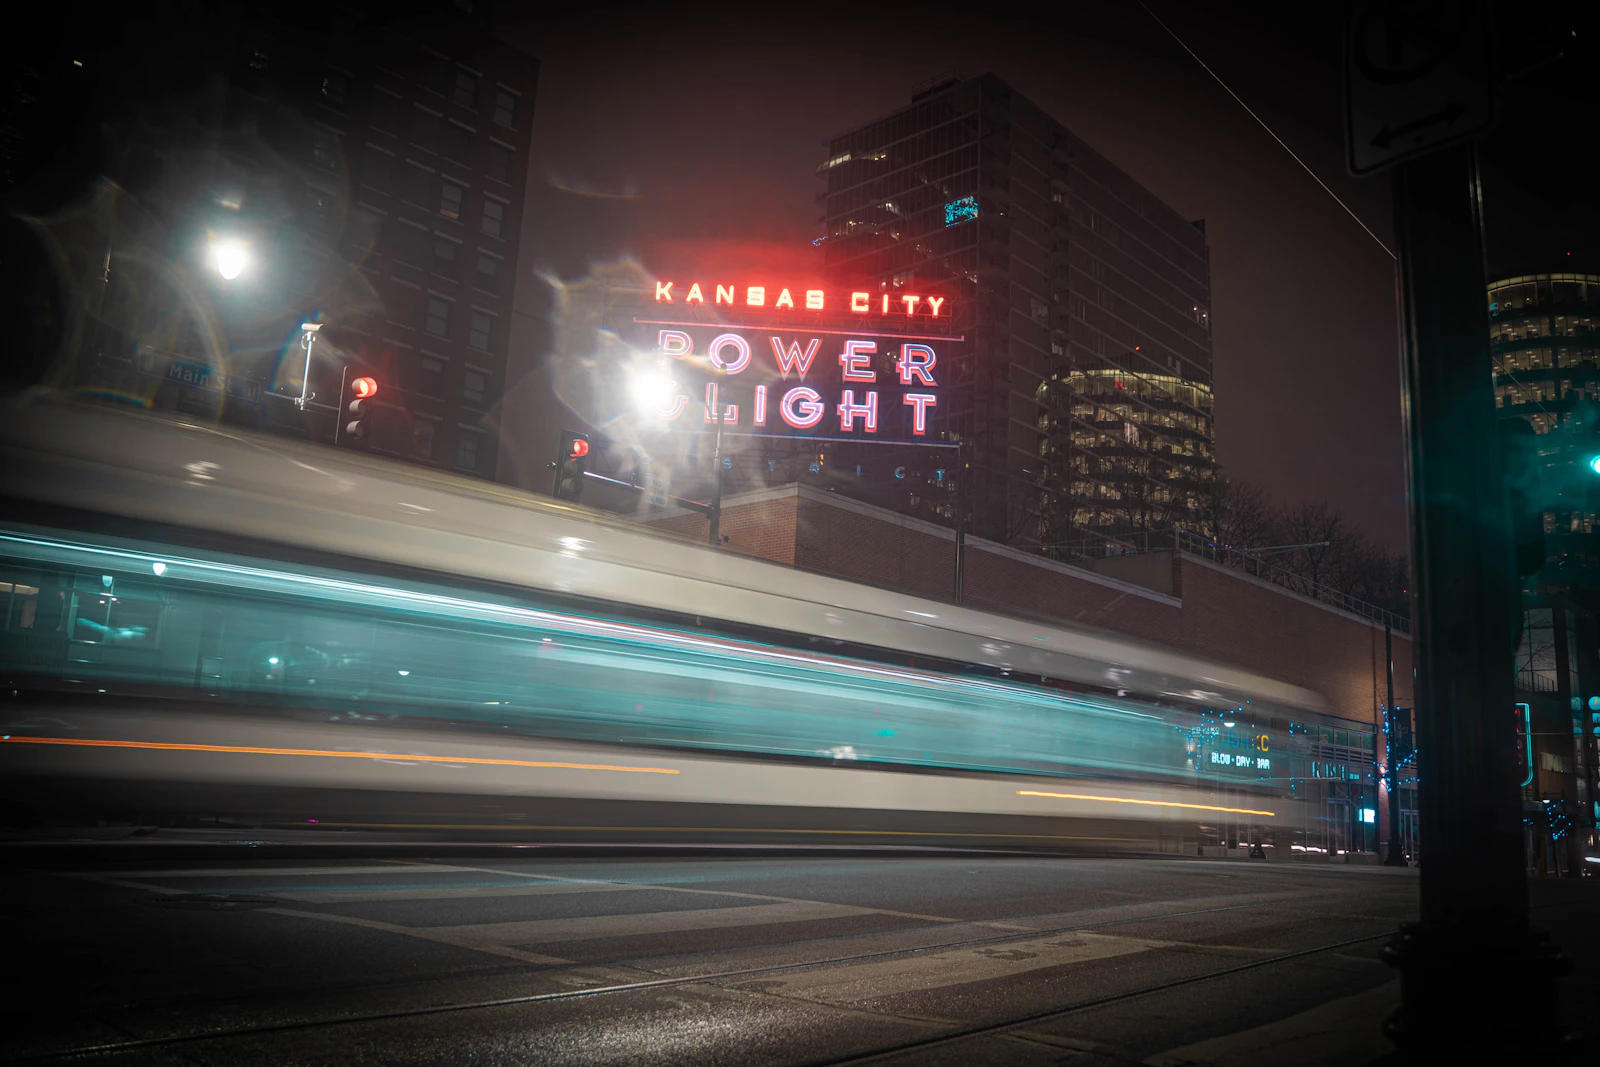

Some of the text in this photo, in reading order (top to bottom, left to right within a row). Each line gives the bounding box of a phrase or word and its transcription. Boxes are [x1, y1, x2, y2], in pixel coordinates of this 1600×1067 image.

[655, 281, 944, 318] KANSAS CITY
[657, 329, 938, 386] POWER
[169, 363, 233, 392] Main St
[704, 382, 937, 435] LIGHT
[682, 455, 946, 481] STRICT
